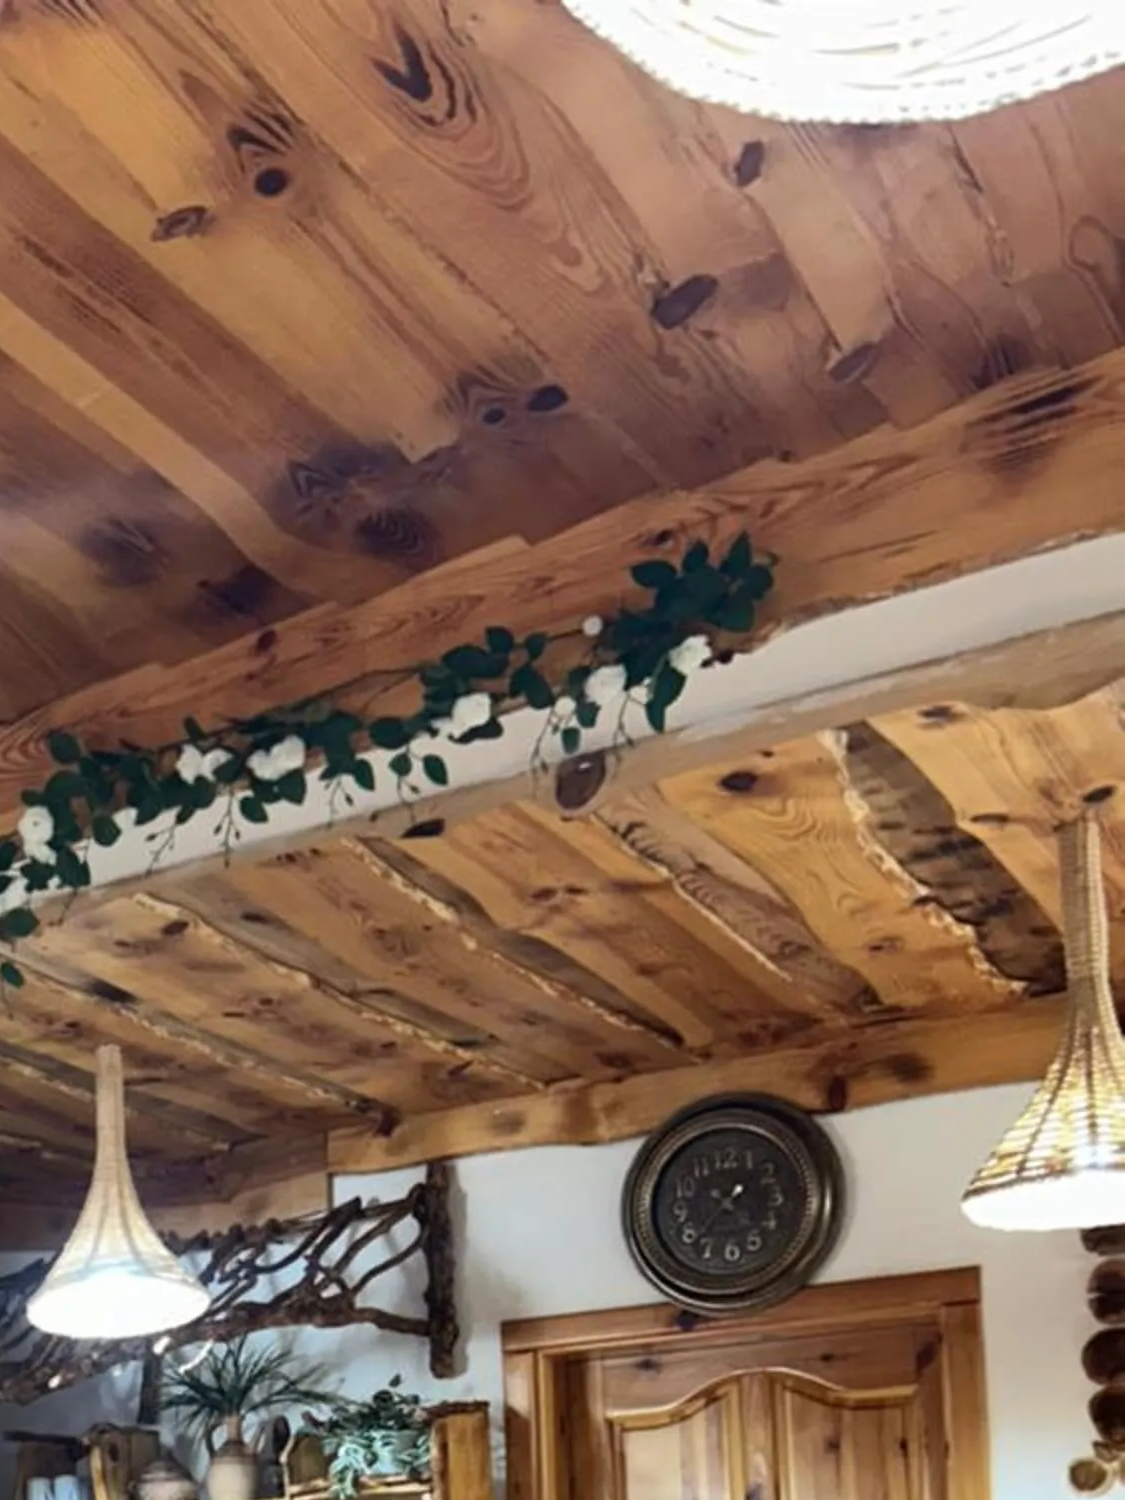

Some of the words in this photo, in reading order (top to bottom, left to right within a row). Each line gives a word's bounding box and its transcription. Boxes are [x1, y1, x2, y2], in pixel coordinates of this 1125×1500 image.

[715, 1147, 738, 1169] 12
[760, 1162, 776, 1185] 2
[673, 1200, 688, 1223] 9
[700, 1237, 712, 1258] 7
[724, 1240, 741, 1262] 6
